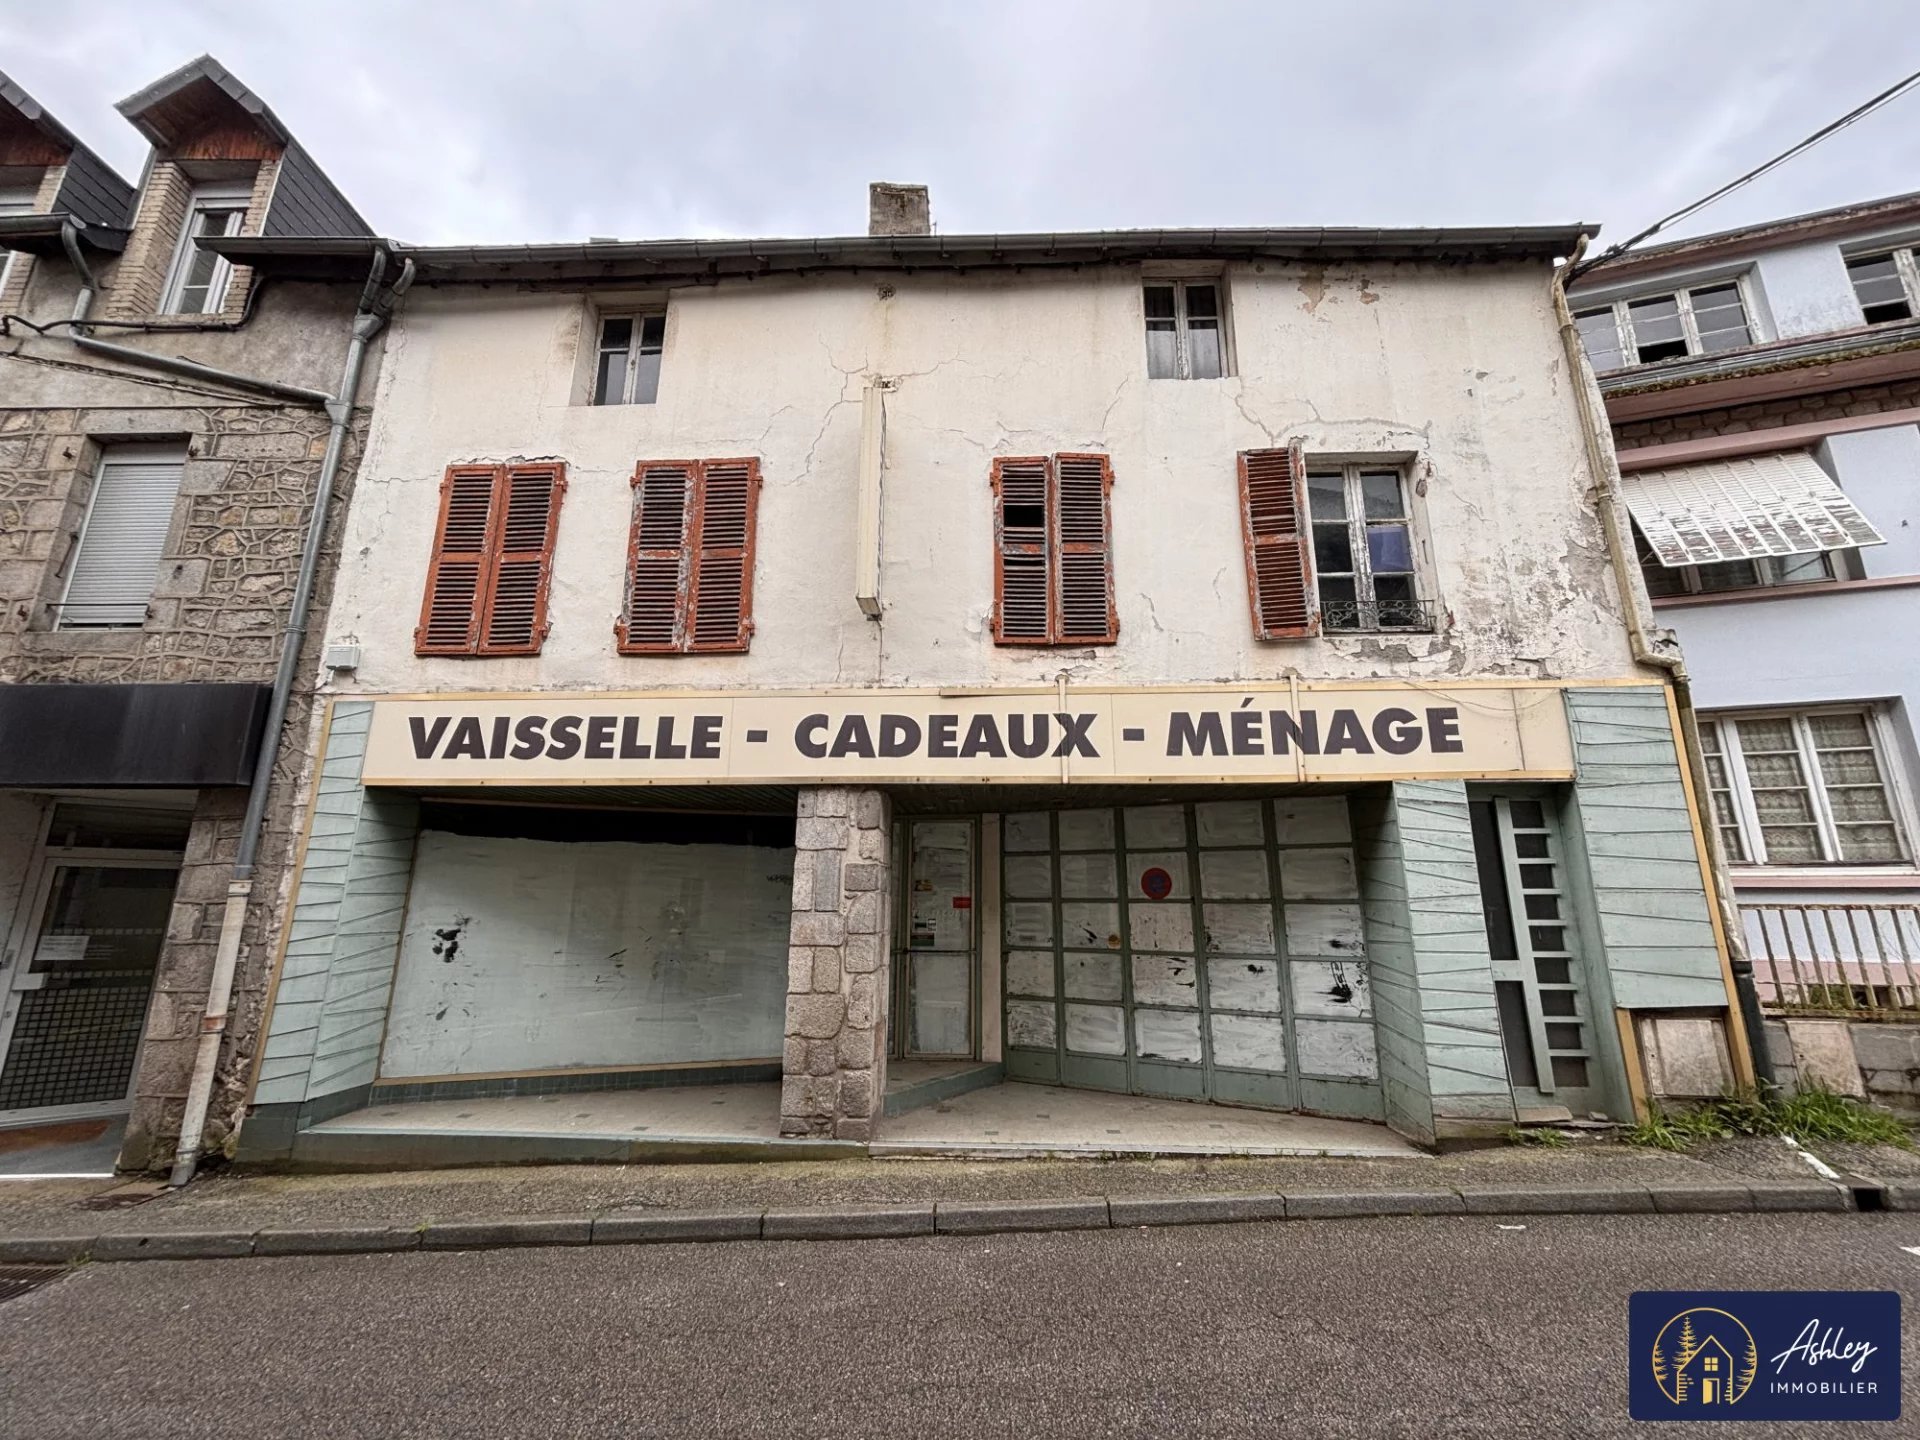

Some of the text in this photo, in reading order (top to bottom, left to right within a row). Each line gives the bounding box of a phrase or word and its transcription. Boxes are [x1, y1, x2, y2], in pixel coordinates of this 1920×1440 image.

[408, 715, 724, 760] VAISSELLE
[794, 713, 1101, 759] CADEAUX
[1166, 697, 1464, 757] MÉNAGE
